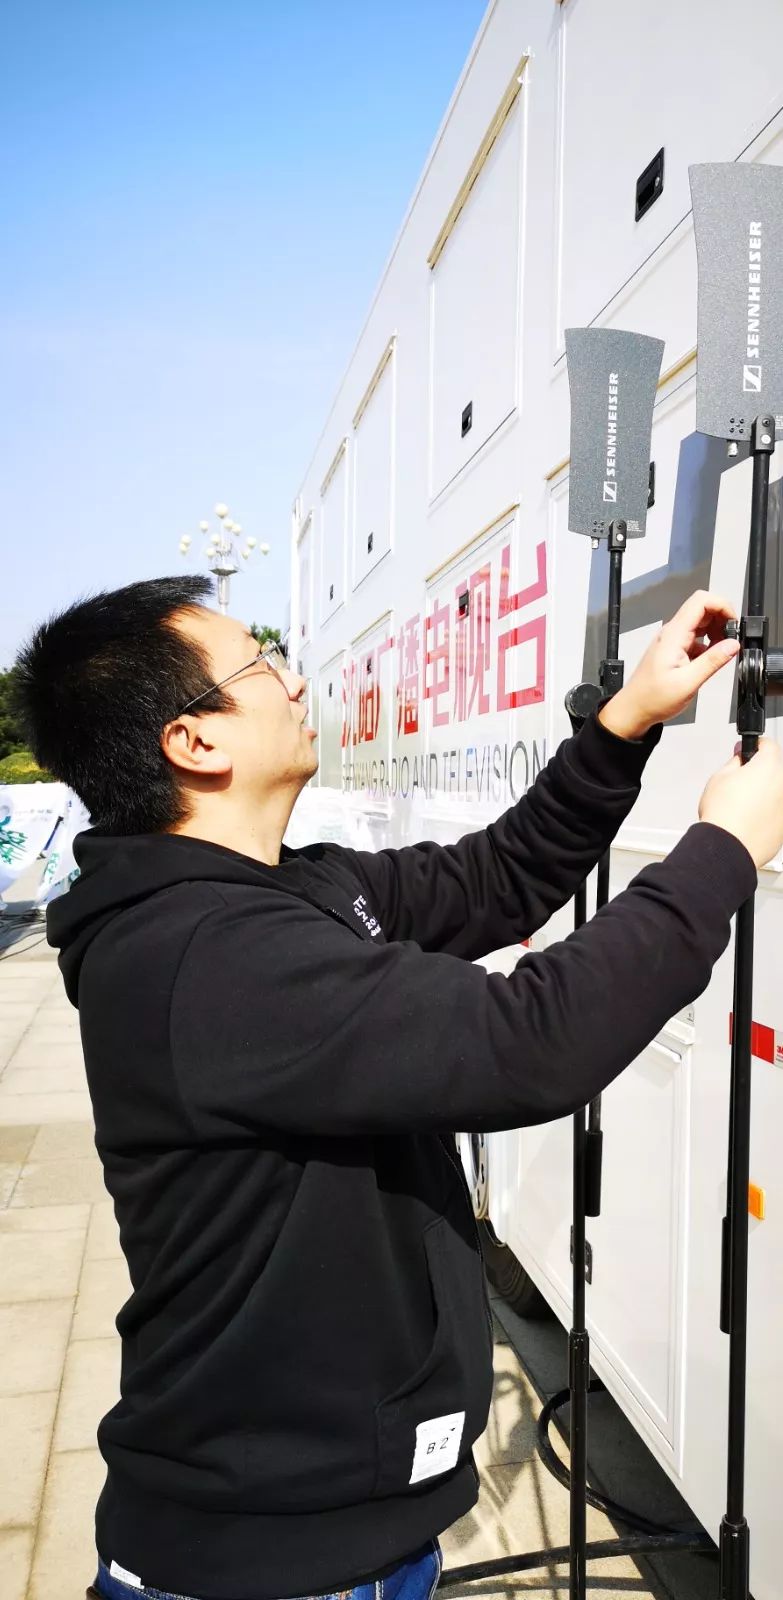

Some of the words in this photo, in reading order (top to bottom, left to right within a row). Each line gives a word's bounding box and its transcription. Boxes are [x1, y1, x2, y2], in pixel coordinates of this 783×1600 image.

[747, 221, 762, 359] SENNHEISER
[606, 372, 619, 477] SENNHEISER
[411, 753, 438, 800] AND
[442, 738, 547, 803] TELEVISION
